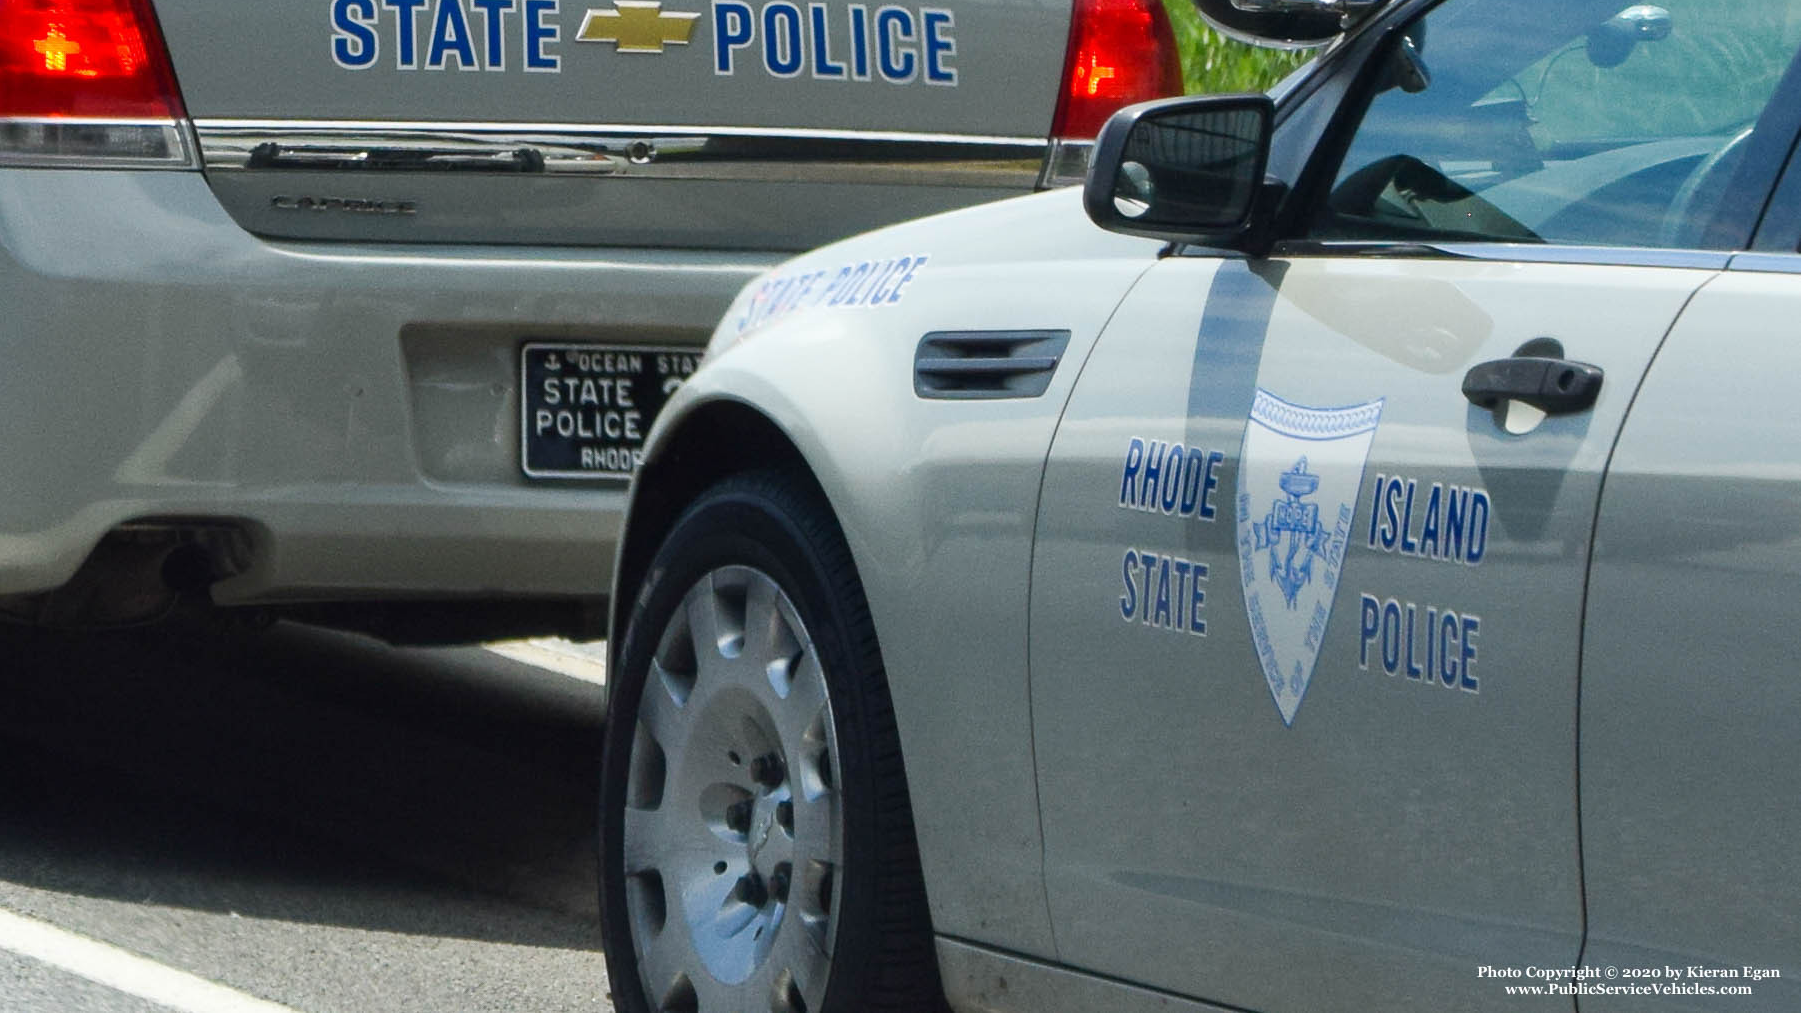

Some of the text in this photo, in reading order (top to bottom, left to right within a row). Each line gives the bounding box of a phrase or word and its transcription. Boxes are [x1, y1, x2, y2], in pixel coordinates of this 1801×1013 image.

[737, 255, 929, 333] STATE POLICE
[578, 353, 643, 373] OCEAN
[543, 378, 634, 408] STATE
[535, 409, 643, 440] POLICE
[1119, 436, 1491, 566] RHODE ISLAND
[1119, 547, 1482, 695] STATE POLICE
